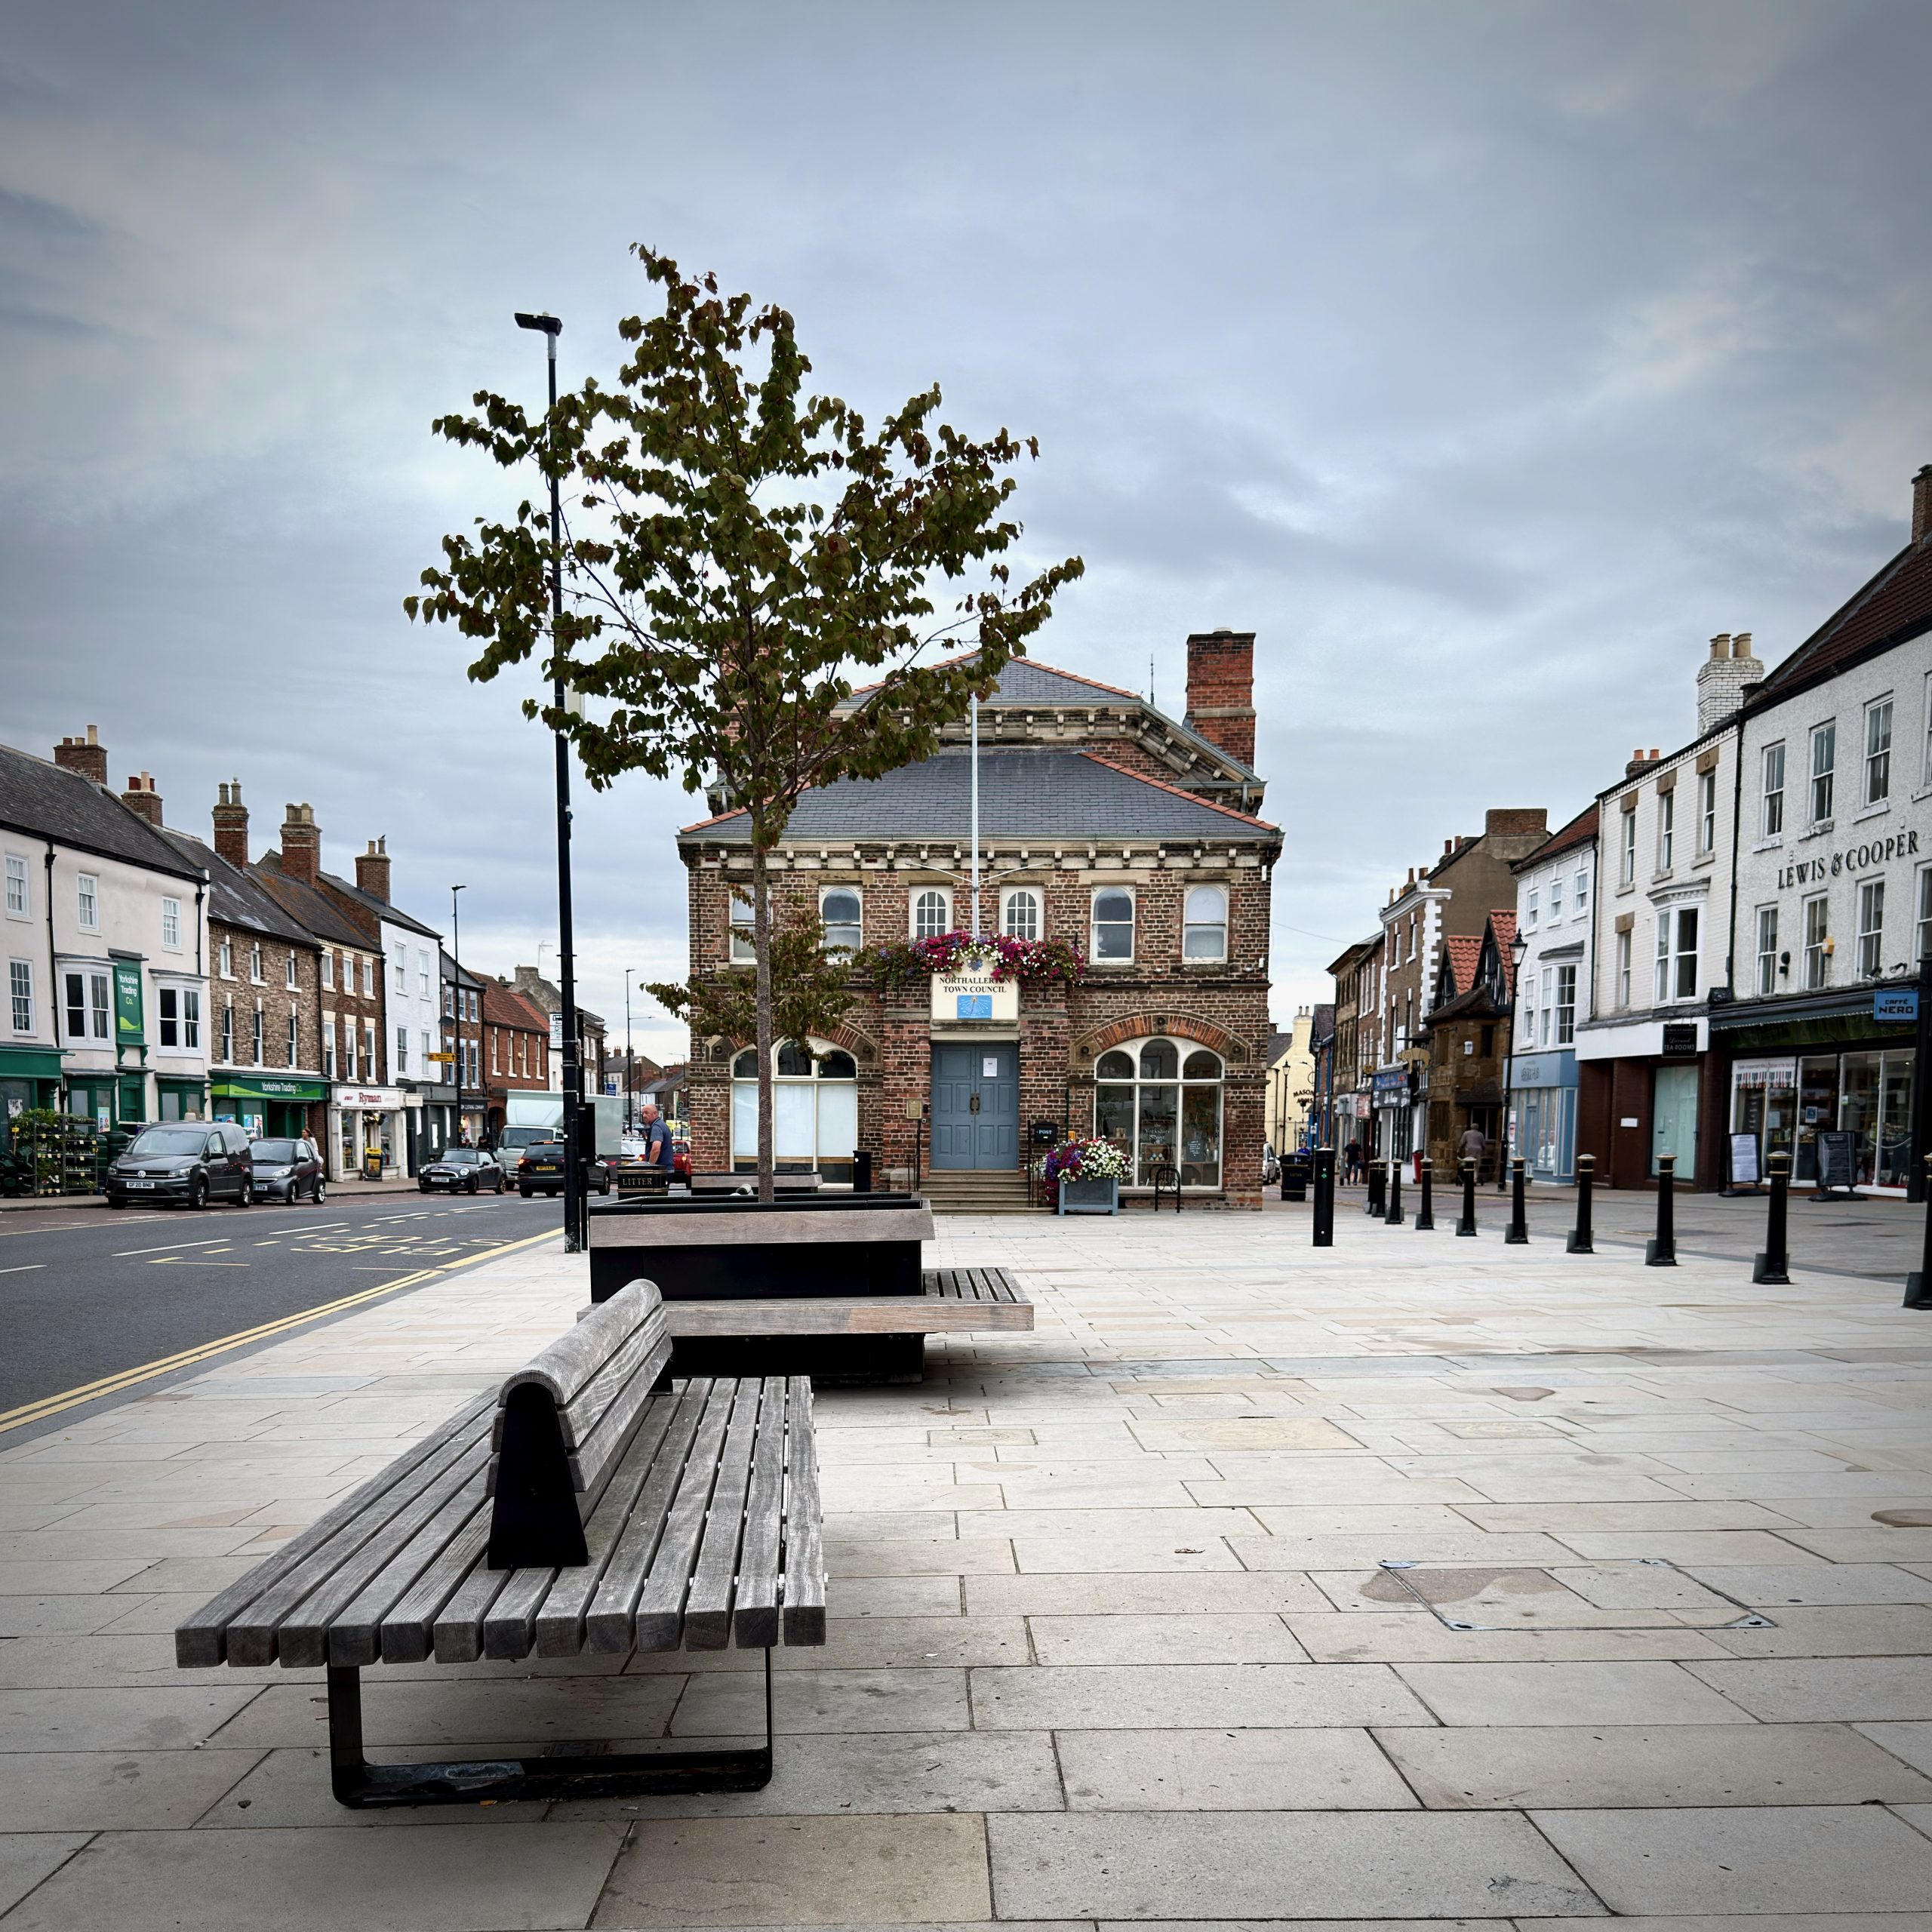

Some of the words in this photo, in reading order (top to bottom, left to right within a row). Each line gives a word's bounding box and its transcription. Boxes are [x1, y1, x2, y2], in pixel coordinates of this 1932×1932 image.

[1777, 857, 1826, 889] LEWIS
[1831, 852, 1844, 877] &
[1846, 830, 1919, 872] COOPER
[118, 974, 139, 985] Yorkshire
[121, 985, 137, 997] Trading
[1878, 1006, 1914, 1014] NERO
[261, 1081, 281, 1092] Yorkshire
[280, 1082, 297, 1094] Trading
[358, 1092, 382, 1105] Ryman
[622, 1177, 653, 1186] LITTER
